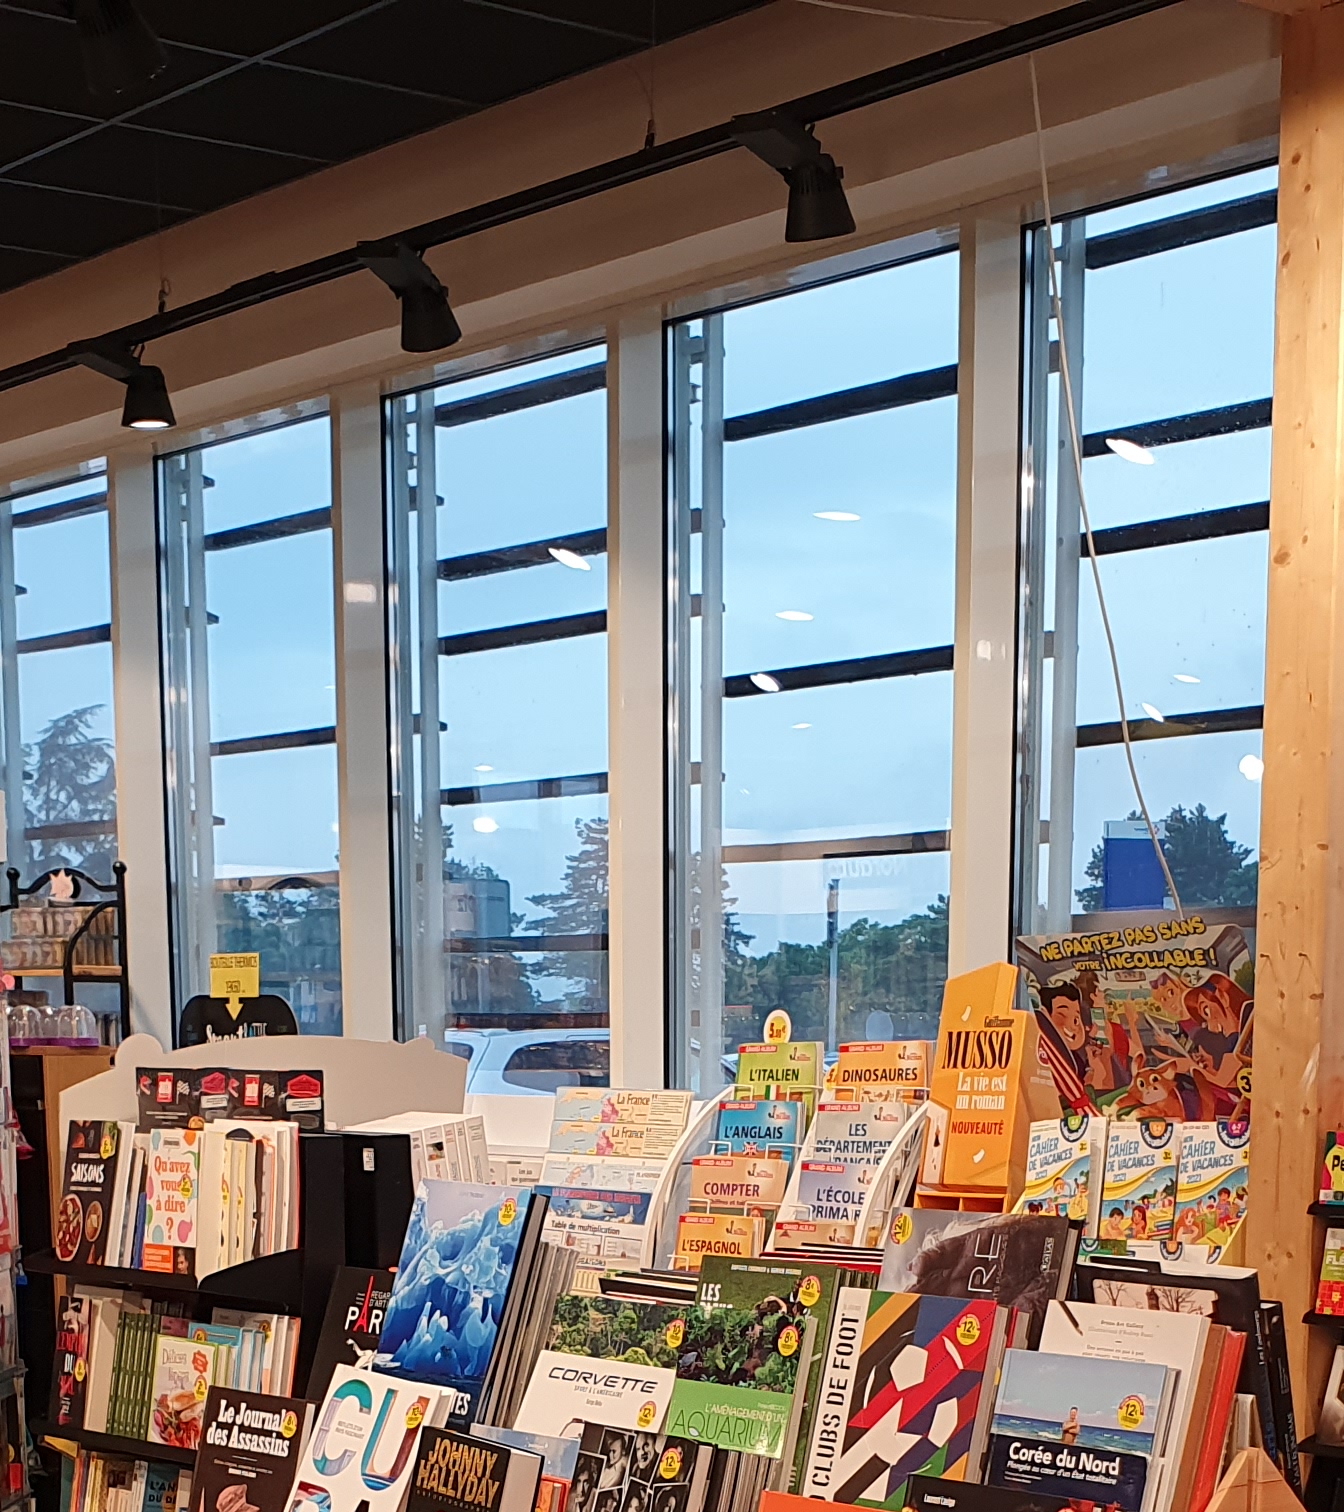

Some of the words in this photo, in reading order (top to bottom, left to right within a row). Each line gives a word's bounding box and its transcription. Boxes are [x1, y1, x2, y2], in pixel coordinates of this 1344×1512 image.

[1040, 943, 1061, 961] NE
[1063, 930, 1122, 956] PARTEZ
[1125, 926, 1156, 945] PAS
[1159, 917, 1205, 940] SANS
[1073, 960, 1102, 971] VOTRE
[942, 1030, 1014, 1070] MUSSO
[749, 1068, 799, 1082] L'ITALIEN
[842, 1068, 918, 1082] DINOSAURES
[958, 1073, 970, 1090] La
[974, 1073, 989, 1090] vie
[991, 1074, 1008, 1091] est
[617, 1094, 625, 1104] La
[627, 1094, 650, 1105] France
[972, 1095, 1005, 1110] roman
[724, 1126, 783, 1139] L'ANGLAIS
[848, 1123, 867, 1136] LES
[952, 1119, 1003, 1136] NOUVEAUTÉ
[71, 1161, 105, 1184] SAISONS
[154, 1155, 191, 1175] Qu'avez
[704, 1182, 760, 1197] COMPTER
[816, 1187, 866, 1204] L'ÉCOLE
[165, 1197, 186, 1214] dire
[682, 1239, 742, 1254] L'ESPAGNOL
[832, 1314, 859, 1373] FOOT
[548, 1367, 658, 1394] CORVETTE
[826, 1379, 846, 1408] DE
[218, 1399, 233, 1422] Le
[234, 1403, 285, 1432] Journal
[672, 1409, 784, 1448] AQUARIUM
[207, 1425, 228, 1446] des
[229, 1429, 290, 1458] Assassins
[812, 1411, 842, 1485] CLUBS
[427, 1437, 498, 1476] JOHNNY
[1009, 1442, 1052, 1465] Corée
[1056, 1449, 1076, 1468] du
[1078, 1453, 1120, 1475] Nord
[416, 1458, 500, 1509] HALLYDAY
